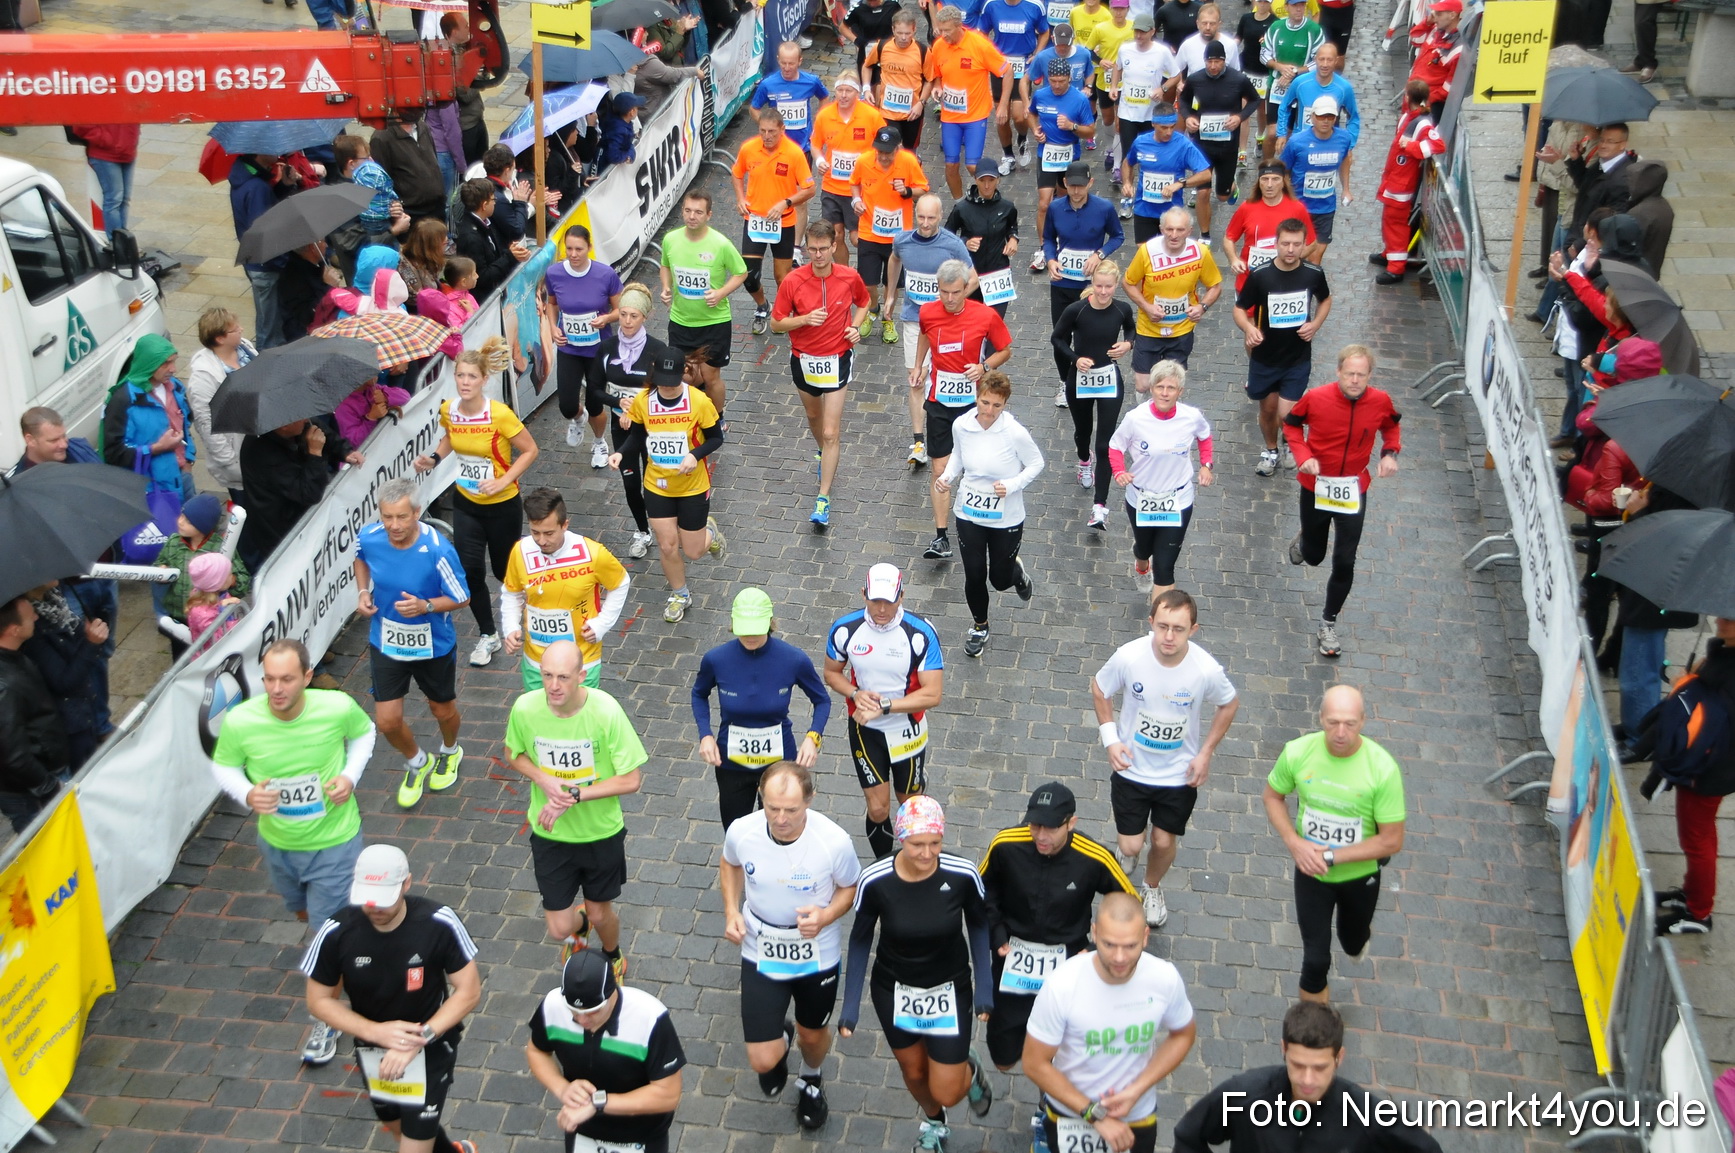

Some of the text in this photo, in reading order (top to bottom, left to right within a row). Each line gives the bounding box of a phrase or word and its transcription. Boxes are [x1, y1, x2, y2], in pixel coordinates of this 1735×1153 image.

[1050, 8, 1071, 18] 2772
[999, 22, 1025, 31] HUBER
[1482, 27, 1548, 48] Jugend-
[1498, 48, 1530, 64] lauf
[1009, 62, 1023, 72] 65
[126, 69, 206, 93] 09181
[215, 67, 285, 91] 6352
[886, 91, 910, 105] 3100
[943, 91, 965, 105] 2704
[1129, 87, 1146, 98] 133
[782, 108, 805, 120] 2610
[1045, 151, 1070, 162] 2479
[1307, 152, 1339, 162] HUBER
[1307, 178, 1334, 189] 2776
[751, 219, 779, 233] 3156
[874, 214, 900, 228] 2671
[1153, 262, 1203, 283] MAX BÖGL
[678, 274, 707, 289] 2943
[908, 279, 939, 294] 2856
[984, 277, 1011, 294] 2184
[1159, 303, 1187, 315] 894
[1272, 300, 1304, 315] 2262
[566, 321, 595, 335] 2941
[808, 360, 832, 375] 568
[939, 380, 973, 395] 2285
[1080, 374, 1112, 387] 3191
[669, 415, 692, 424] BÖGL
[469, 426, 494, 434] BÖGL
[650, 440, 684, 455] 2957
[659, 456, 679, 465] Andrea
[460, 463, 489, 480] 2887
[1324, 485, 1351, 500] 186
[965, 492, 1001, 510] 2247
[972, 510, 989, 519] Heike
[1149, 514, 1168, 522] Bärbel
[135, 534, 169, 545] adidas
[258, 400, 444, 666] BMW EfficientDynami
[528, 566, 594, 587] MAX BÖGL
[312, 560, 357, 627] Verbrau
[531, 615, 569, 633] 3095
[386, 630, 427, 647] 2080
[902, 723, 921, 740] 40
[1139, 720, 1184, 741] 2392
[739, 738, 773, 755] 384
[903, 739, 923, 753] Stefan
[1144, 738, 1172, 750] Damian
[547, 751, 583, 768] 148
[746, 756, 766, 765] Tanja
[554, 770, 576, 780] Claus
[280, 785, 318, 805] 942
[278, 806, 314, 817] hristoph
[1307, 820, 1357, 844] 2549
[763, 941, 814, 961] 3083
[1010, 951, 1058, 976] 2911
[1, 962, 61, 1029] Außenplatten
[901, 993, 950, 1017] 2626
[5, 997, 48, 1046] Palisaden
[916, 1018, 936, 1029] Gabi
[12, 1027, 42, 1062] Stufen
[379, 1081, 414, 1094] Christian
[1066, 1133, 1109, 1153] 264
